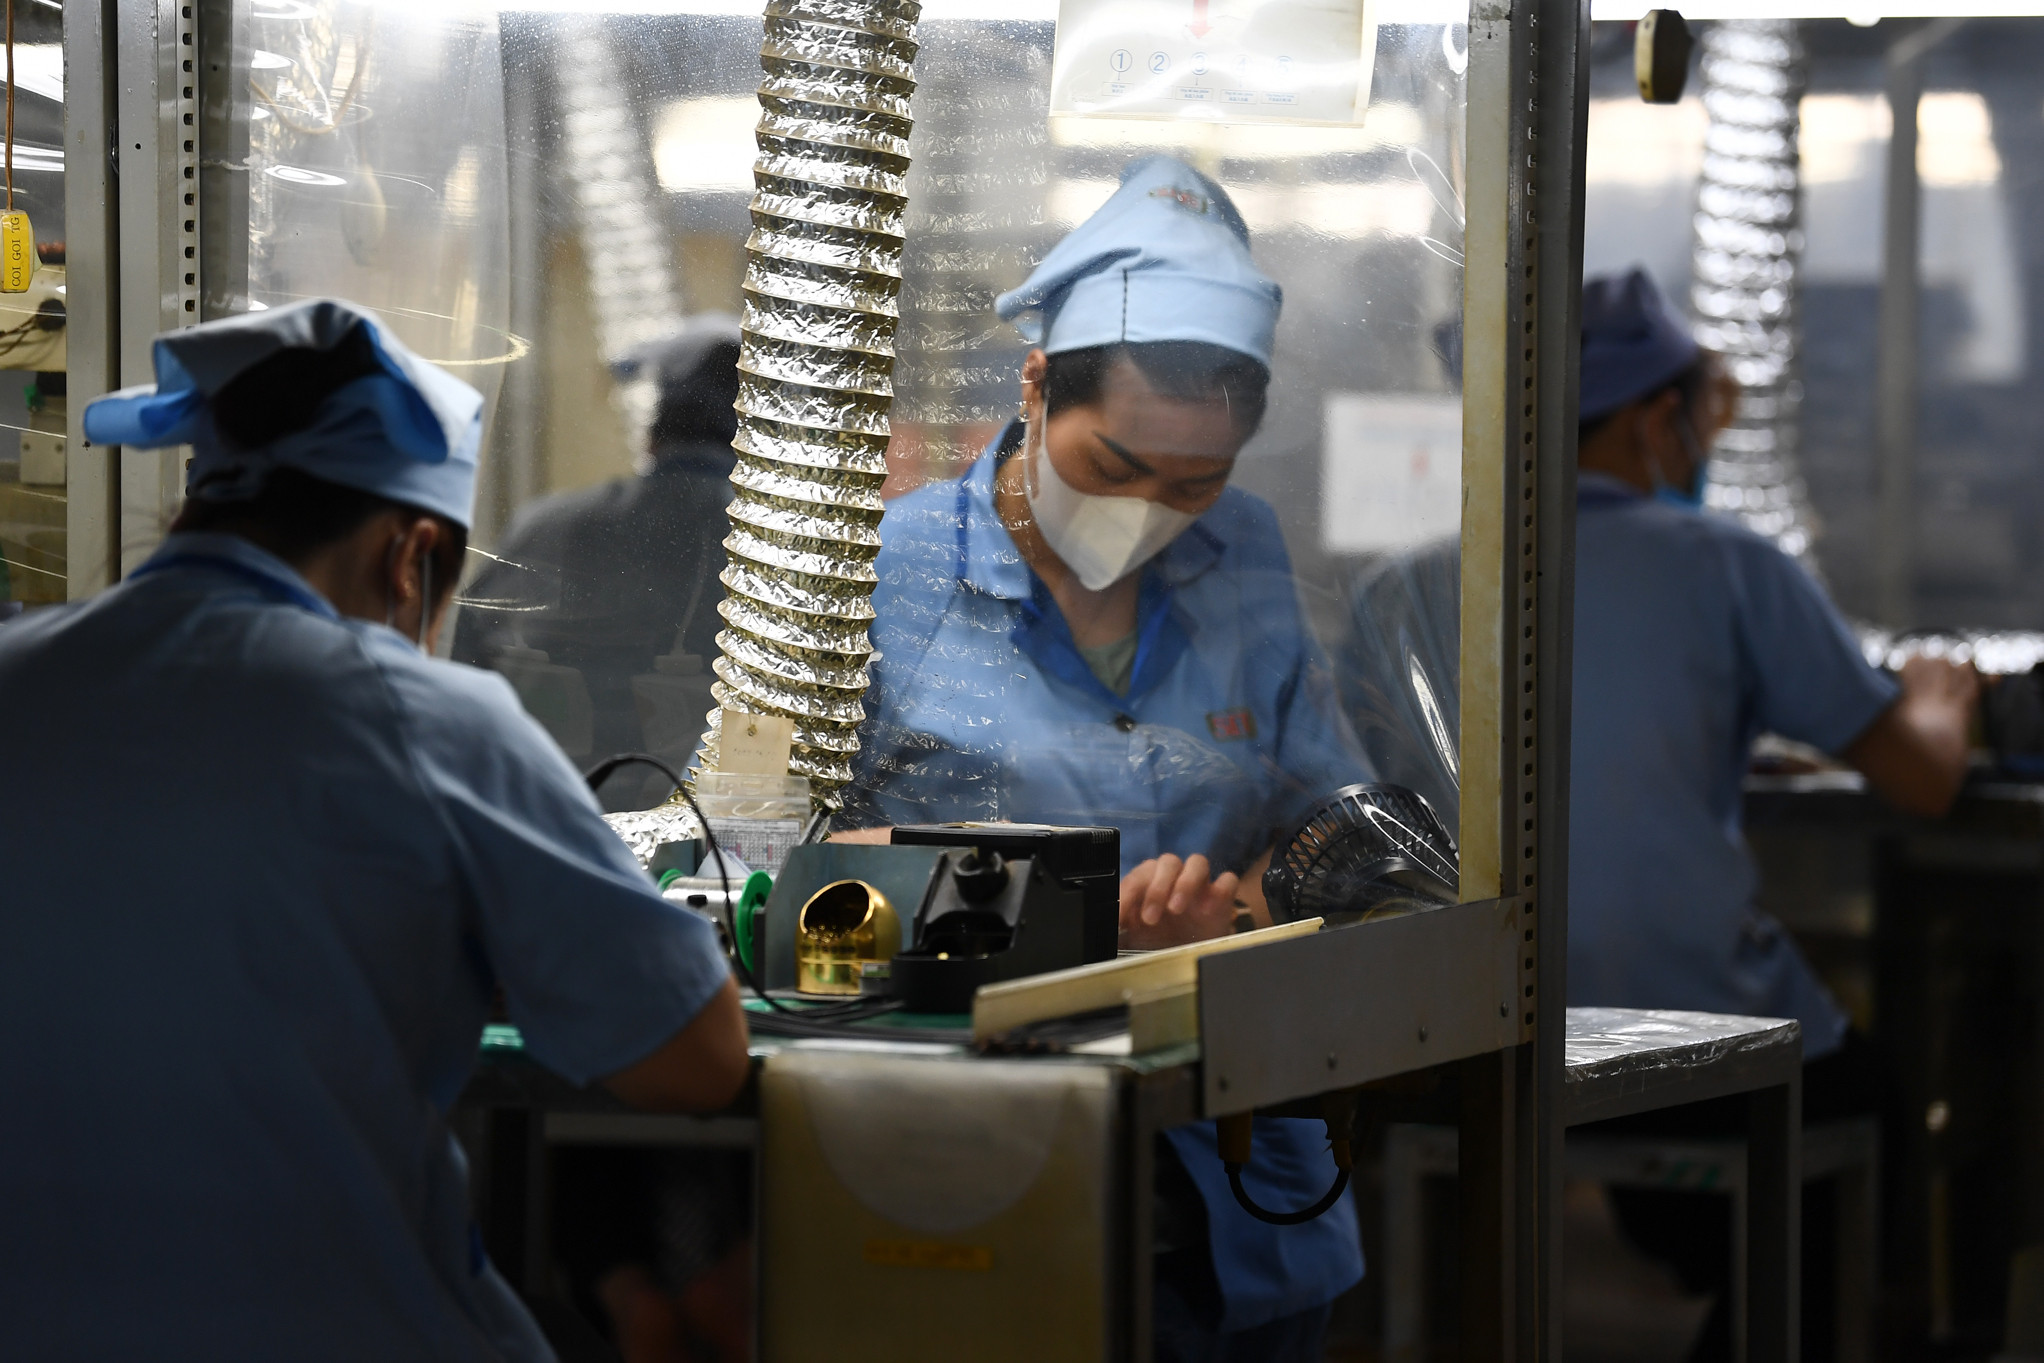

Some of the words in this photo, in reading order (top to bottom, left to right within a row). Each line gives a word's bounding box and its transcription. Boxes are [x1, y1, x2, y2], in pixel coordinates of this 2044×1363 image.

[11, 217, 20, 233] TG
[12, 240, 21, 260] GOI
[12, 267, 21, 287] COI
